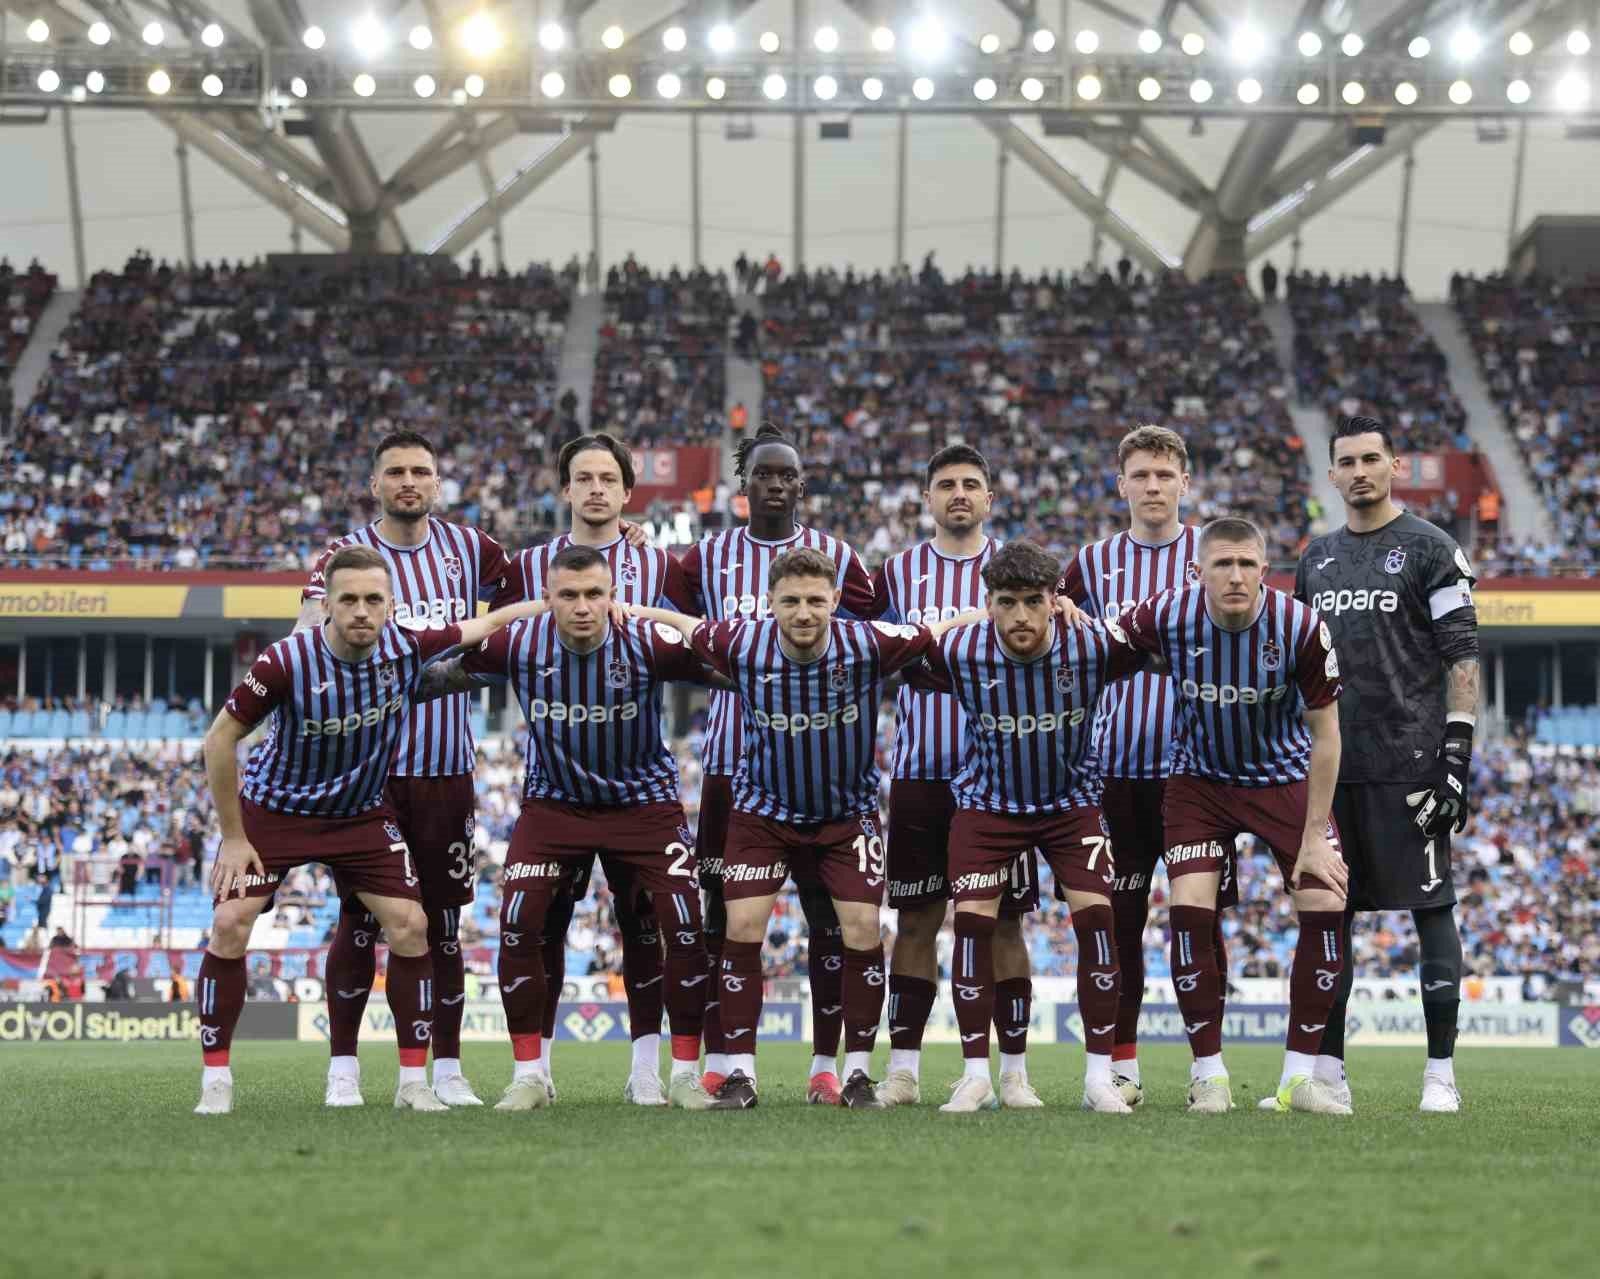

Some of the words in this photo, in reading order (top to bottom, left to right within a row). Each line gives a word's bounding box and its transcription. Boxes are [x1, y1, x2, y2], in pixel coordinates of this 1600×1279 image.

[395, 598, 467, 625] apara
[1312, 589, 1399, 617] papara
[1182, 680, 1288, 708] papara
[302, 695, 403, 737] papara
[530, 698, 638, 727] papara
[753, 703, 860, 737] papara
[979, 707, 1086, 738] papara
[389, 841, 410, 878] 7
[852, 834, 885, 876] 19
[1172, 842, 1207, 864] Rent
[1424, 839, 1438, 880] 1
[511, 862, 547, 881] Rent
[732, 863, 771, 881] Rent
[891, 880, 925, 897] Rent
[1373, 1013, 1423, 1034] VAKI
